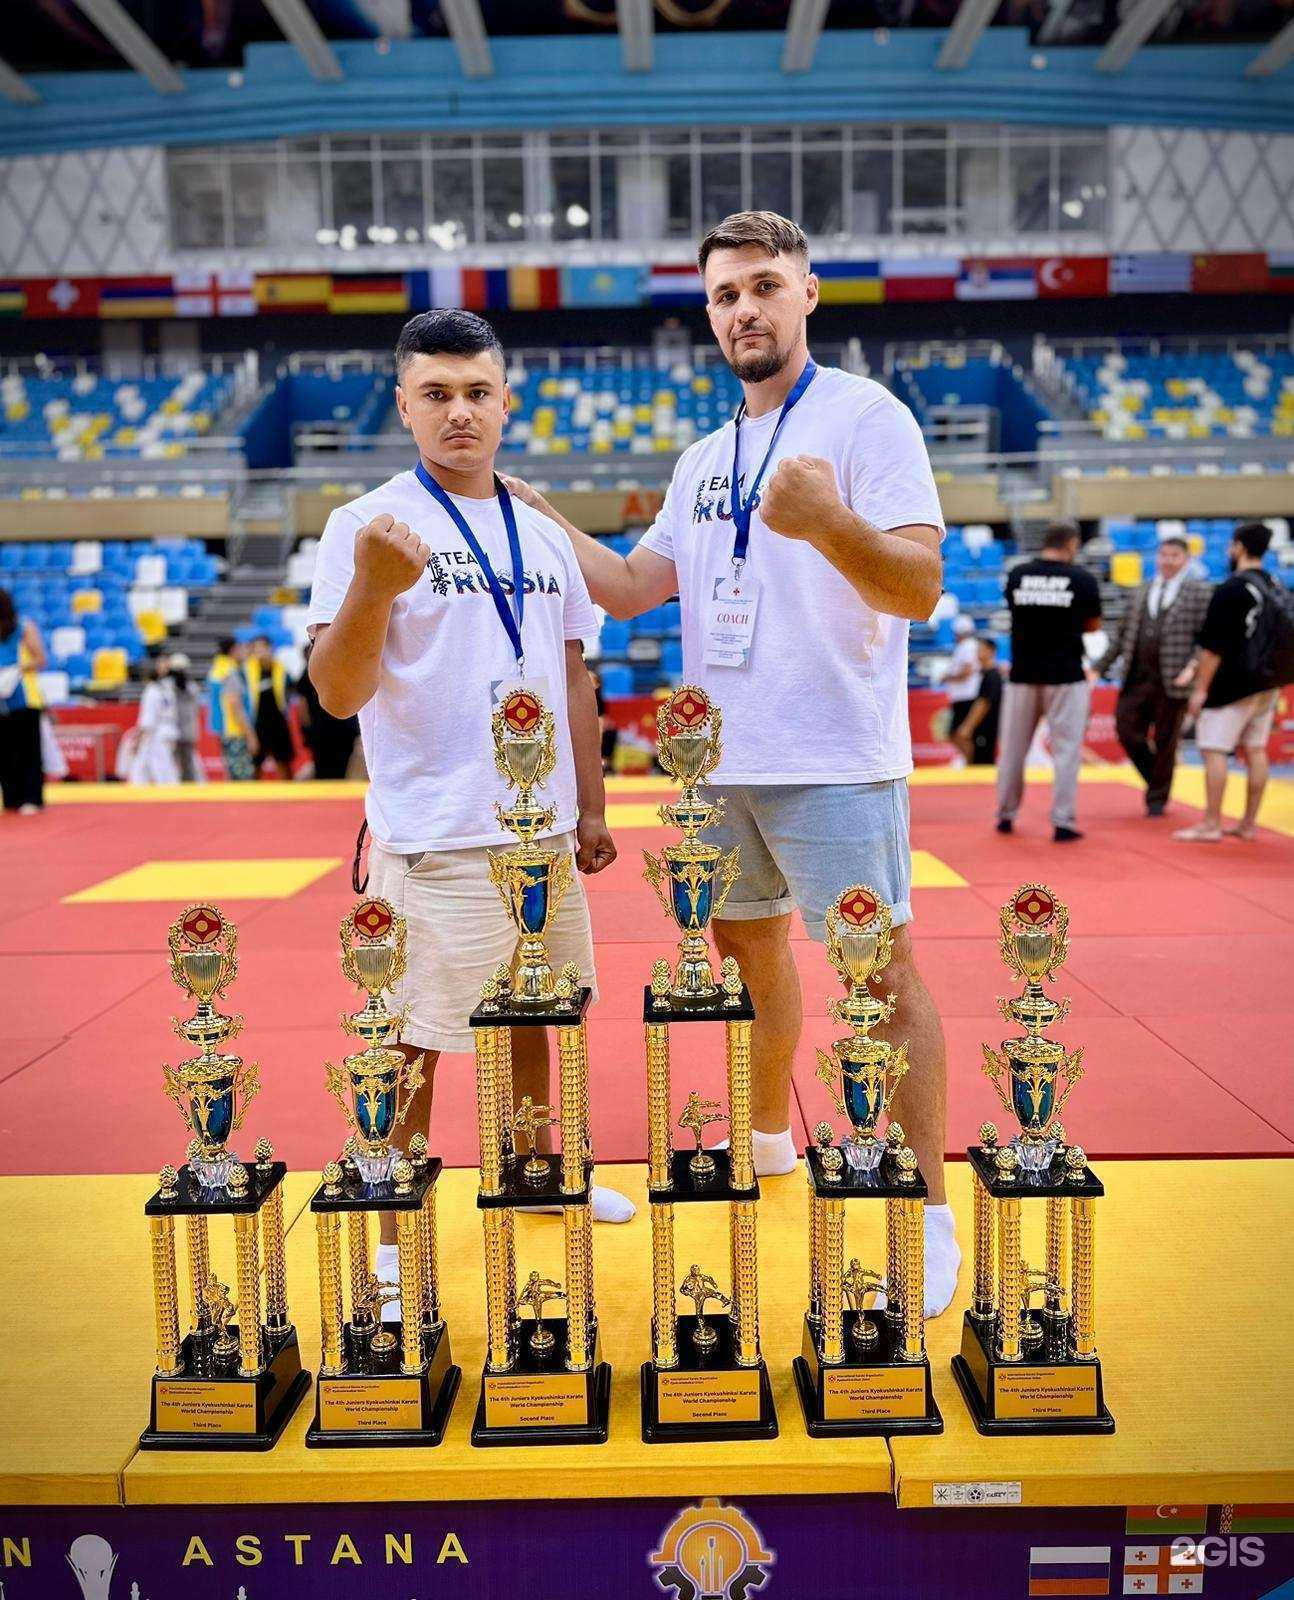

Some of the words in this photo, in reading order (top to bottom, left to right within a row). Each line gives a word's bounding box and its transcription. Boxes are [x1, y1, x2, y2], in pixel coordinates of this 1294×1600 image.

[440, 551, 488, 566] TEA
[717, 613, 750, 625] COACH
[0, 1537, 32, 1567] N
[182, 1532, 470, 1566] ASTANA
